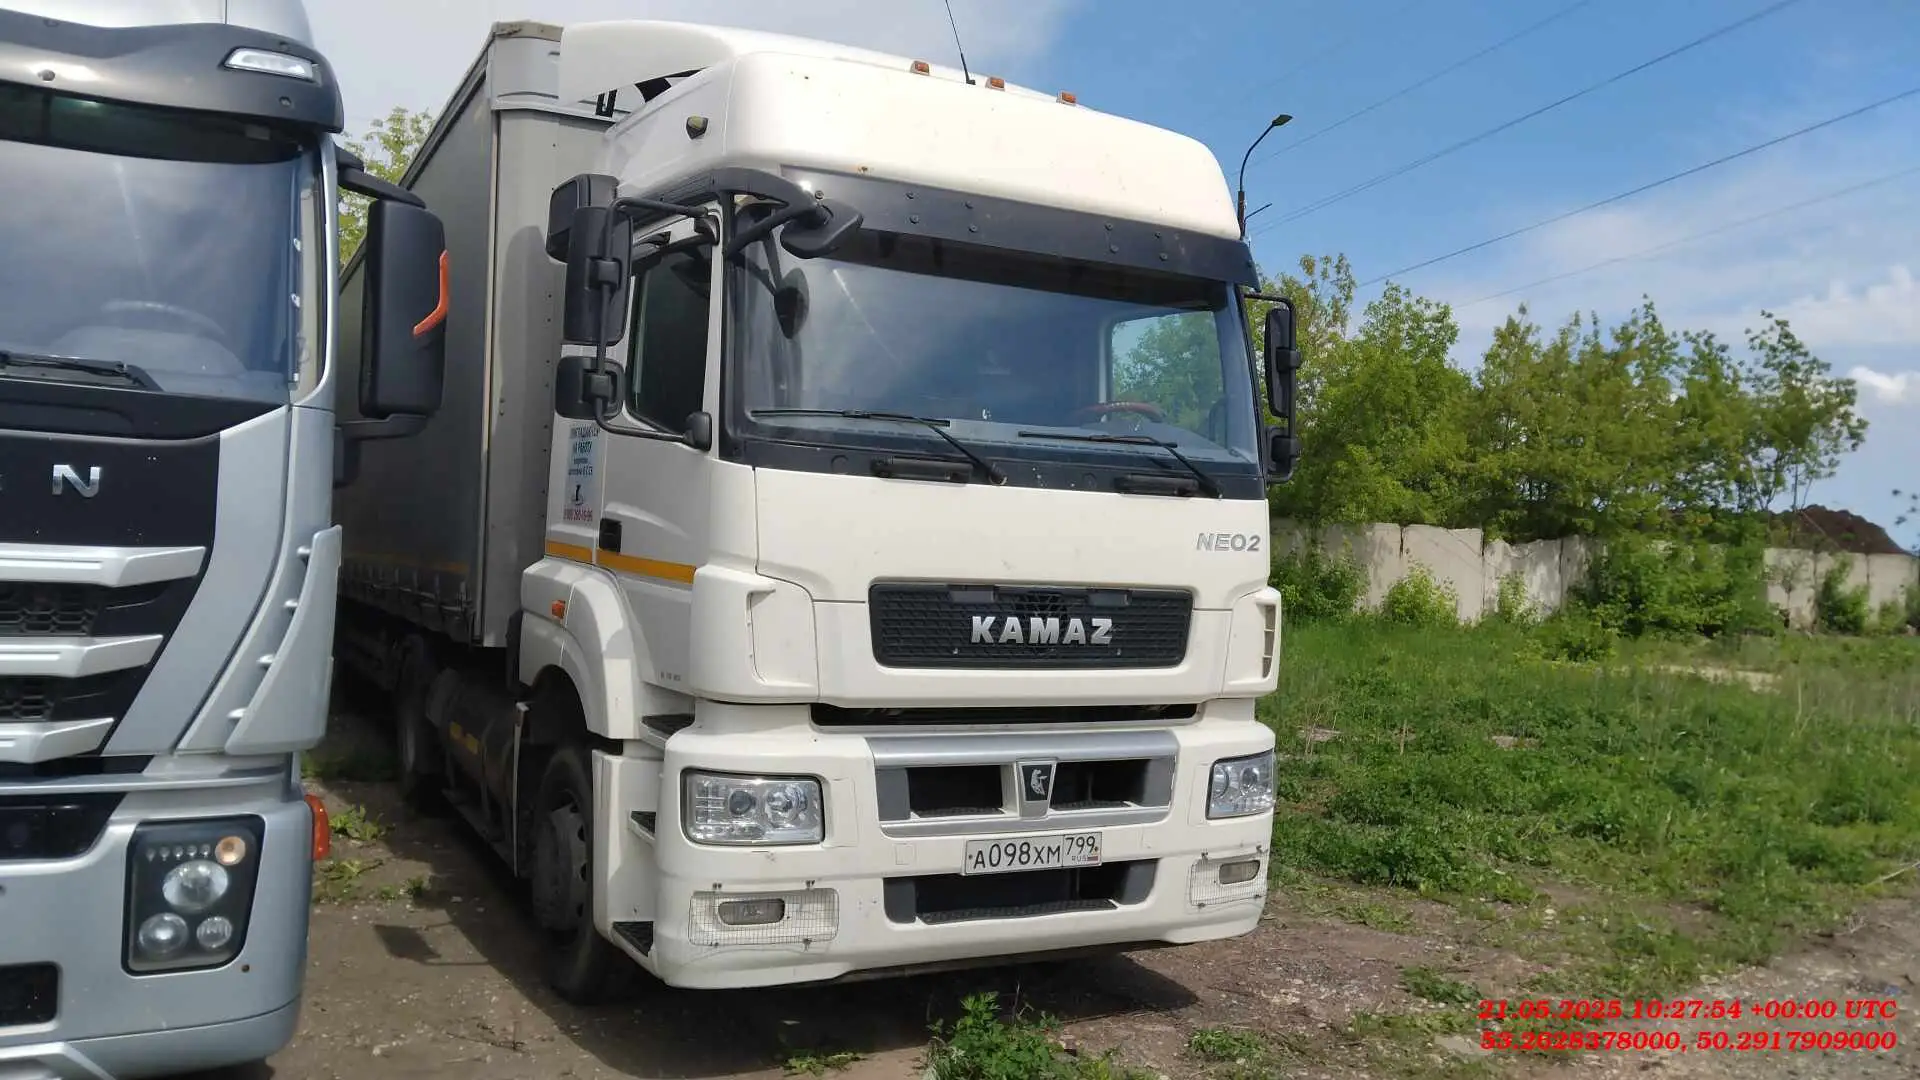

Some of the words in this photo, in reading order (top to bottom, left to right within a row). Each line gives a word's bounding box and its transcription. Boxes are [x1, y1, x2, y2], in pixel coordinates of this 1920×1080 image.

[1196, 532, 1261, 552] NEO2
[971, 616, 1113, 645] KAMAZ
[1065, 836, 1096, 855] 799
